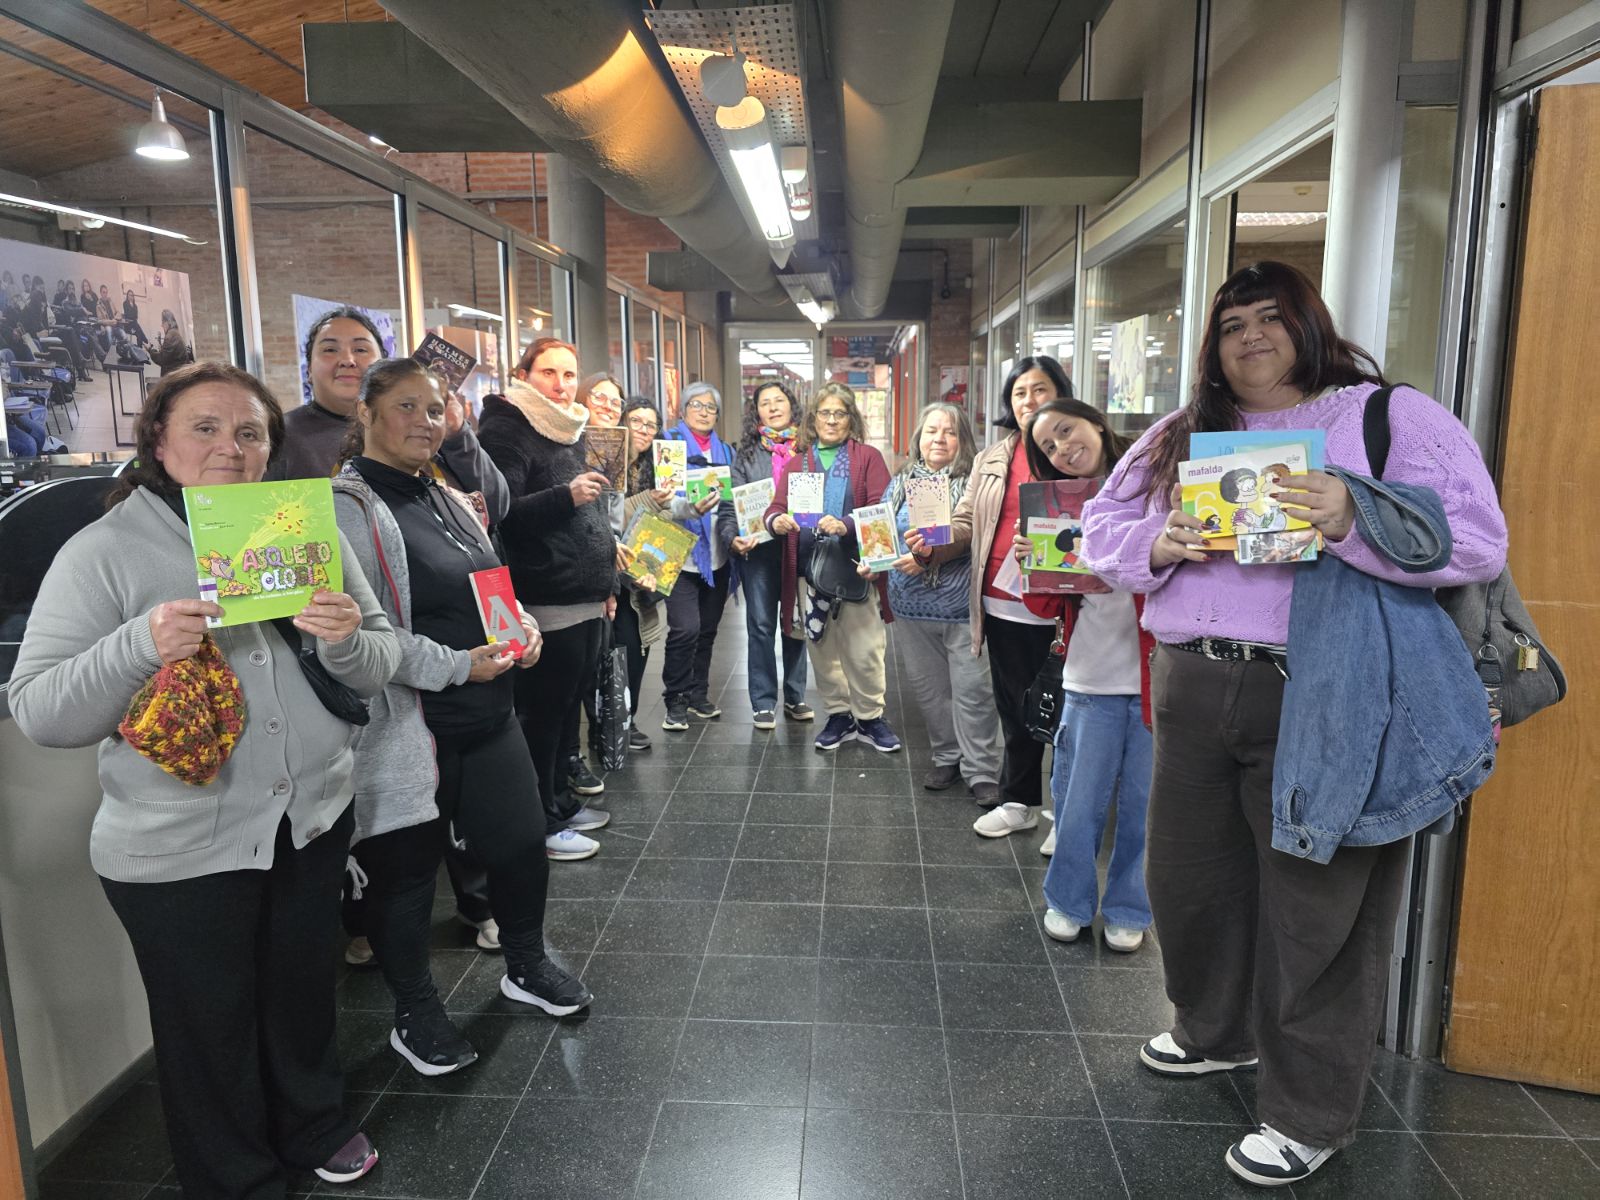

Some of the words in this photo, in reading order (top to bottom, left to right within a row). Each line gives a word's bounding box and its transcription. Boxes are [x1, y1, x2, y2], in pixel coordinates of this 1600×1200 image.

[431, 339, 470, 364] HOLMES
[1188, 464, 1223, 477] mafalda
[243, 541, 332, 572] ASQUERO
[487, 595, 528, 646] A
